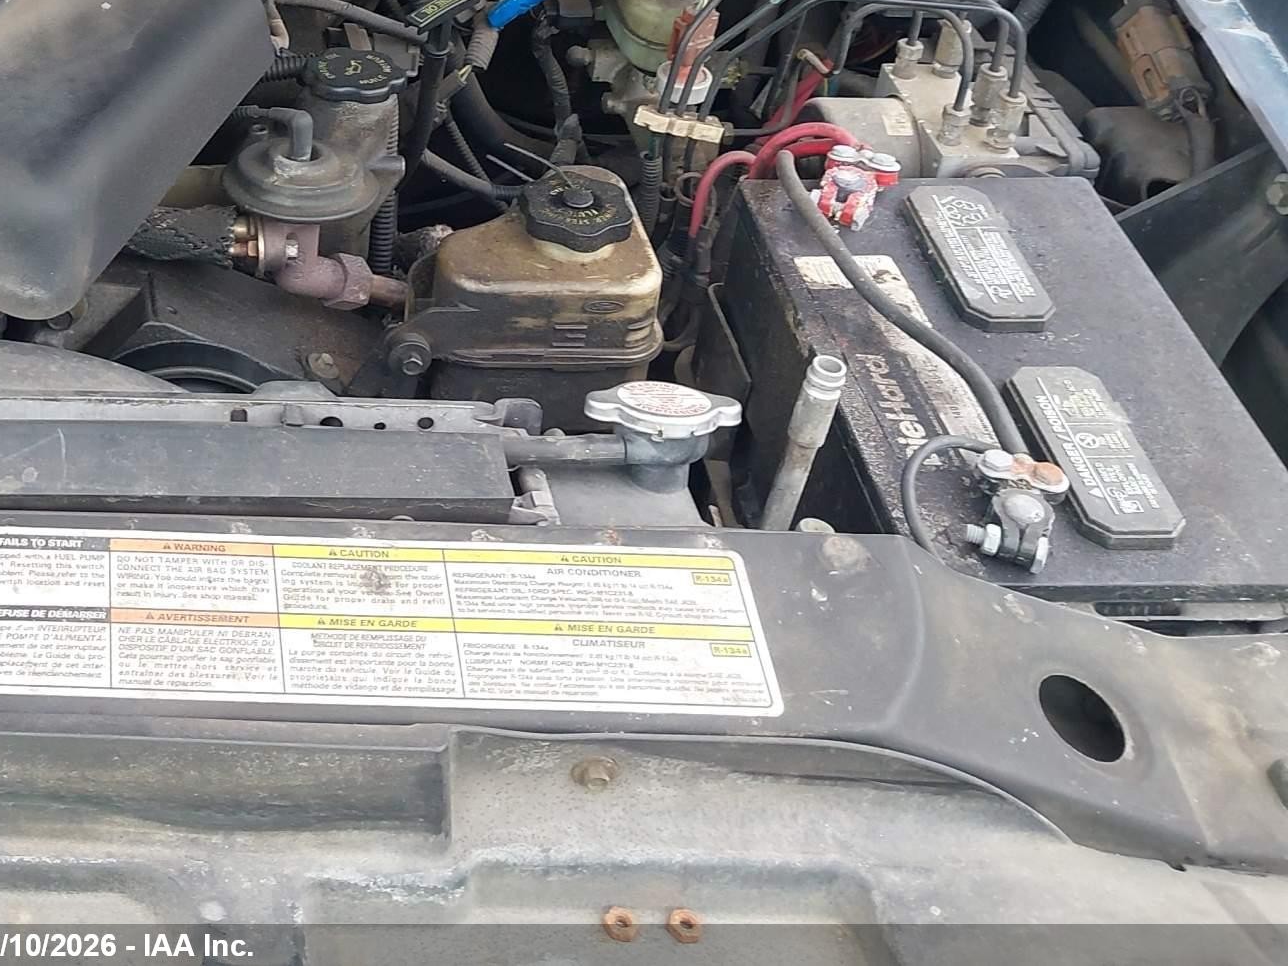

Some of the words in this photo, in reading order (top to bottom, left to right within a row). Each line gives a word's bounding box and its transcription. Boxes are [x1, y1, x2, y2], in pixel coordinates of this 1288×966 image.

[1034, 394, 1066, 435] POISON
[1061, 441, 1097, 487] DANGER
[48, 540, 84, 548] START
[174, 544, 226, 552] WARNING
[340, 549, 390, 558] CAUTION
[158, 557, 199, 565] TAMPER
[572, 555, 622, 564] CAUTION
[116, 564, 161, 572] CONNECT
[230, 568, 269, 576] SYSTEM
[546, 567, 564, 575] AIR
[567, 568, 642, 578] CONDITIONER
[157, 614, 250, 623] AVERTISSEMENT
[378, 620, 417, 628] GARDE
[158, 628, 214, 636] MANIPULER
[567, 624, 594, 632] MISE
[597, 625, 613, 633] EN
[616, 625, 656, 634] GARDE
[118, 644, 167, 652] DISPOSITIF
[572, 638, 646, 649] CLIMATISEUR
